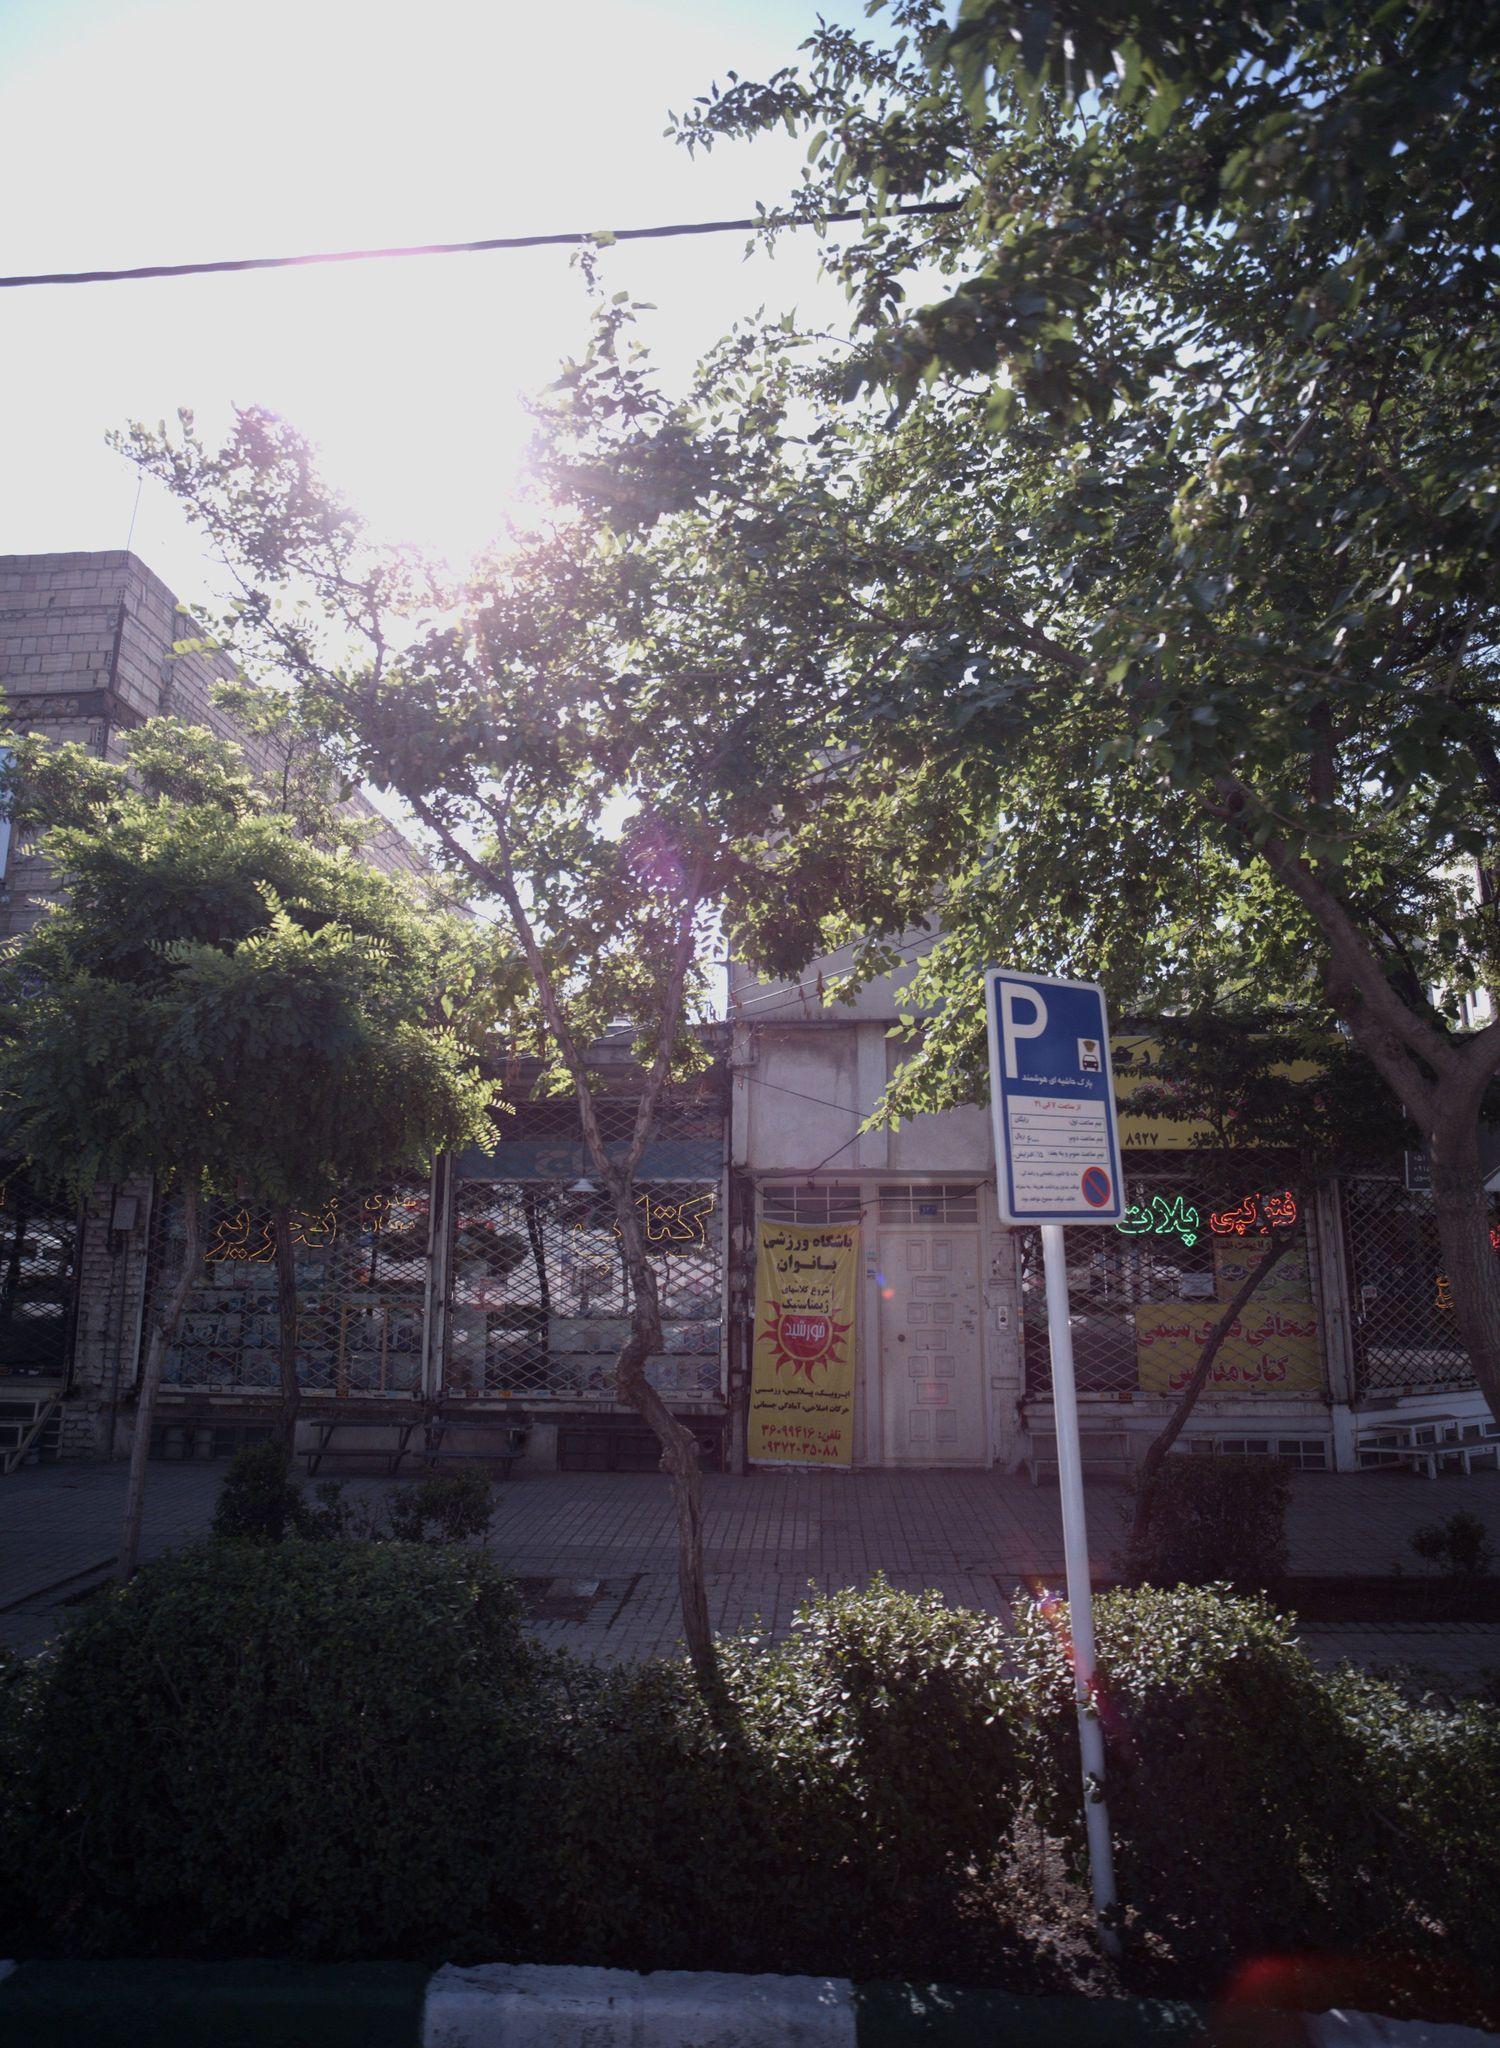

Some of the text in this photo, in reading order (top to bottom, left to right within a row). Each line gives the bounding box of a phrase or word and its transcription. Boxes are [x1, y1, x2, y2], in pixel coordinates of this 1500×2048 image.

[999, 981, 1048, 1079] P
[1021, 1072, 1048, 1086] هوشمند
[1077, 1078, 1094, 1090] پارک
[1115, 1195, 1200, 1247] پلات
[763, 1231, 853, 1252] باشگاه ورزشی
[776, 1254, 837, 1274] بانوان
[781, 1284, 831, 1297] شروع کلاسهای
[781, 1297, 829, 1314] ژیمناستیک
[784, 1319, 826, 1342] خورشید
[753, 1400, 777, 1410] جسمانی
[777, 1402, 801, 1411] آمادگی
[829, 1404, 850, 1415] حرکات
